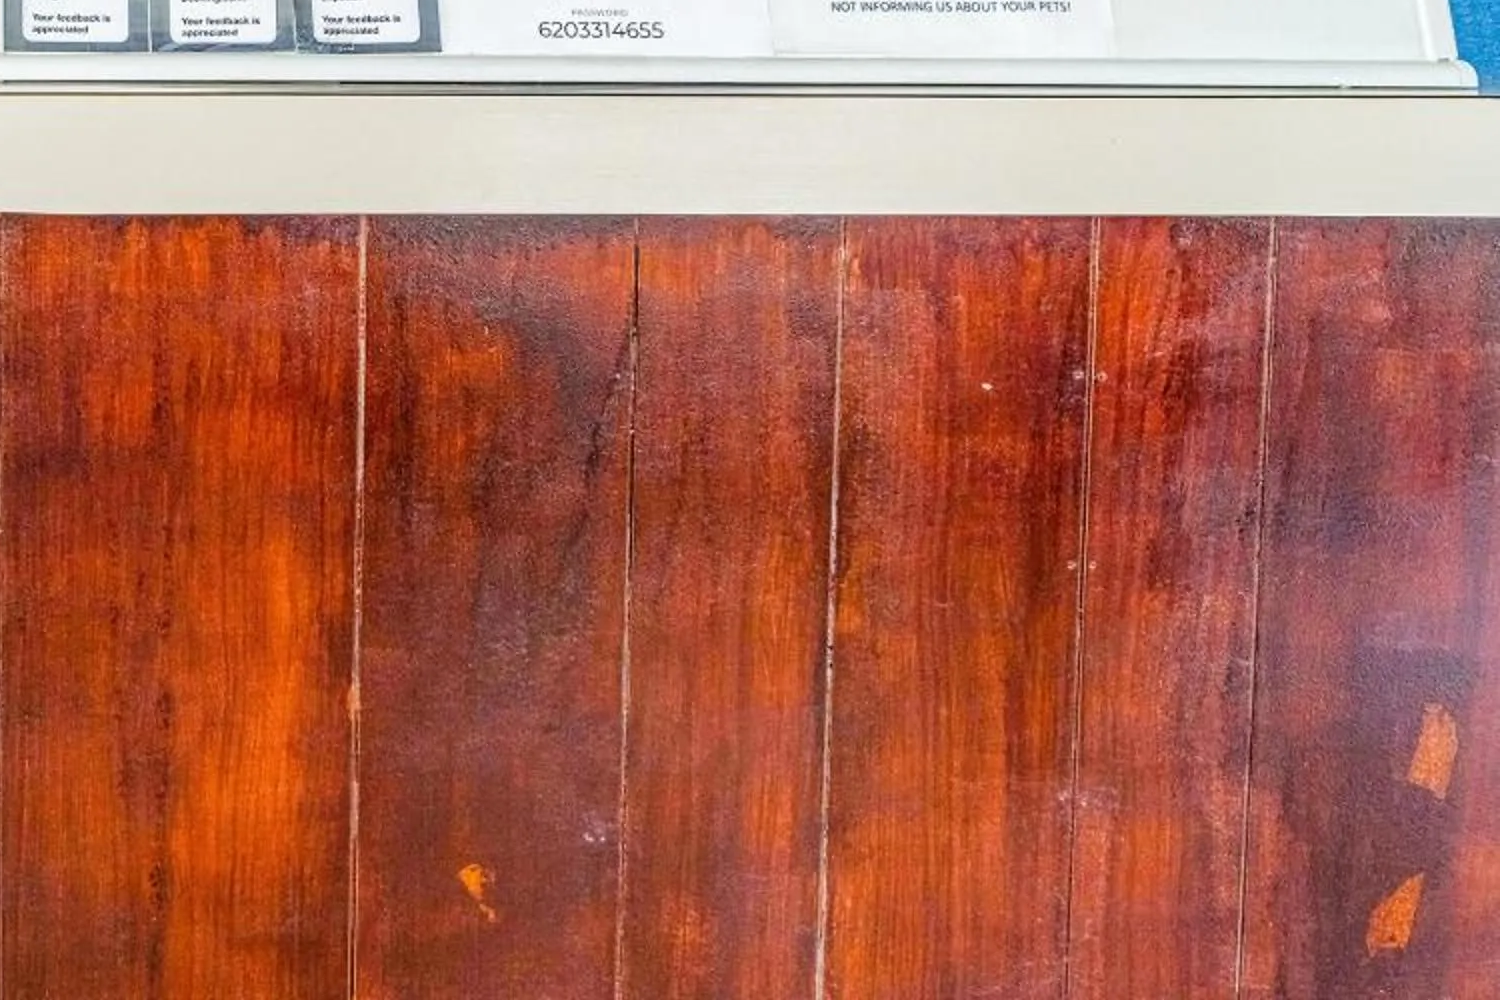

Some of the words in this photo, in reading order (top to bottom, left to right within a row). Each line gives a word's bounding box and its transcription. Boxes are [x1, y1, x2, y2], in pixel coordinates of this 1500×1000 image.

[831, 1, 856, 12] NOT
[860, 1, 933, 12] INFORMING
[936, 1, 953, 12] US
[955, 1, 998, 12] ABOUT
[1002, 1, 1037, 12] YOUR
[1039, 1, 1072, 12] PETS!
[182, 17, 204, 26] Your
[538, 21, 665, 39] 6203314655
